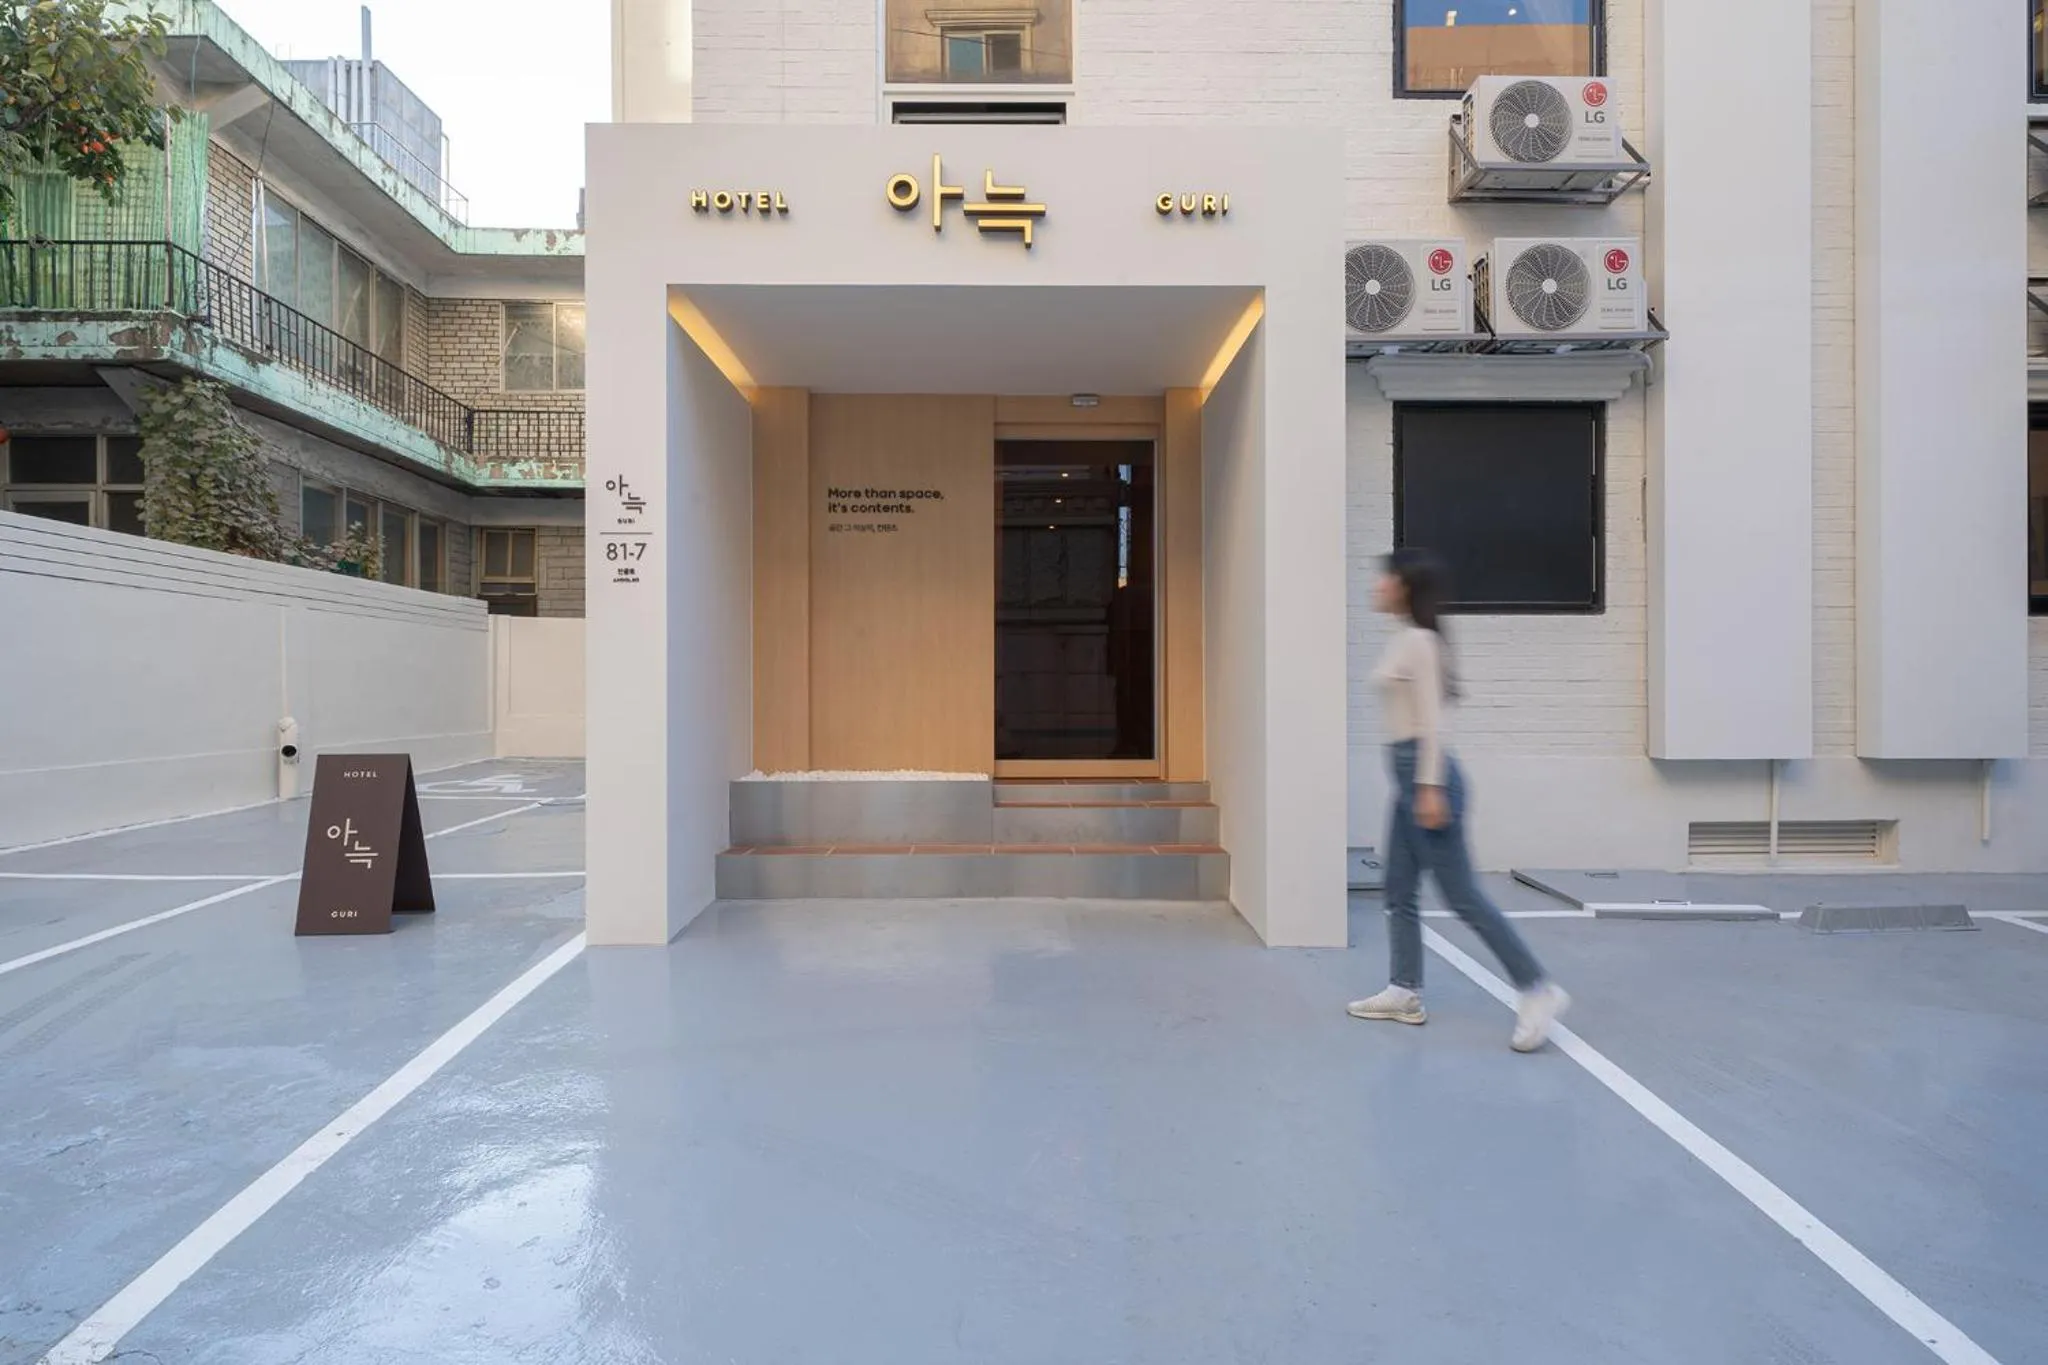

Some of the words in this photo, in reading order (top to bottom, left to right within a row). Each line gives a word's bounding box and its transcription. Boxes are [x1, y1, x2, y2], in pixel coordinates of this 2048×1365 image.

[1585, 111, 1605, 124] LG
[691, 189, 789, 213] HOTEL
[886, 153, 1046, 249] 아늑
[1156, 192, 1229, 216] GURI
[1431, 279, 1451, 291] LG
[1607, 278, 1627, 290] LG
[606, 474, 647, 514] 아늑
[828, 488, 861, 499] More
[864, 488, 896, 499] than
[899, 489, 944, 500] space,
[851, 503, 915, 514] contents.
[606, 542, 647, 561] 81-7
[327, 818, 379, 869] 아늑
